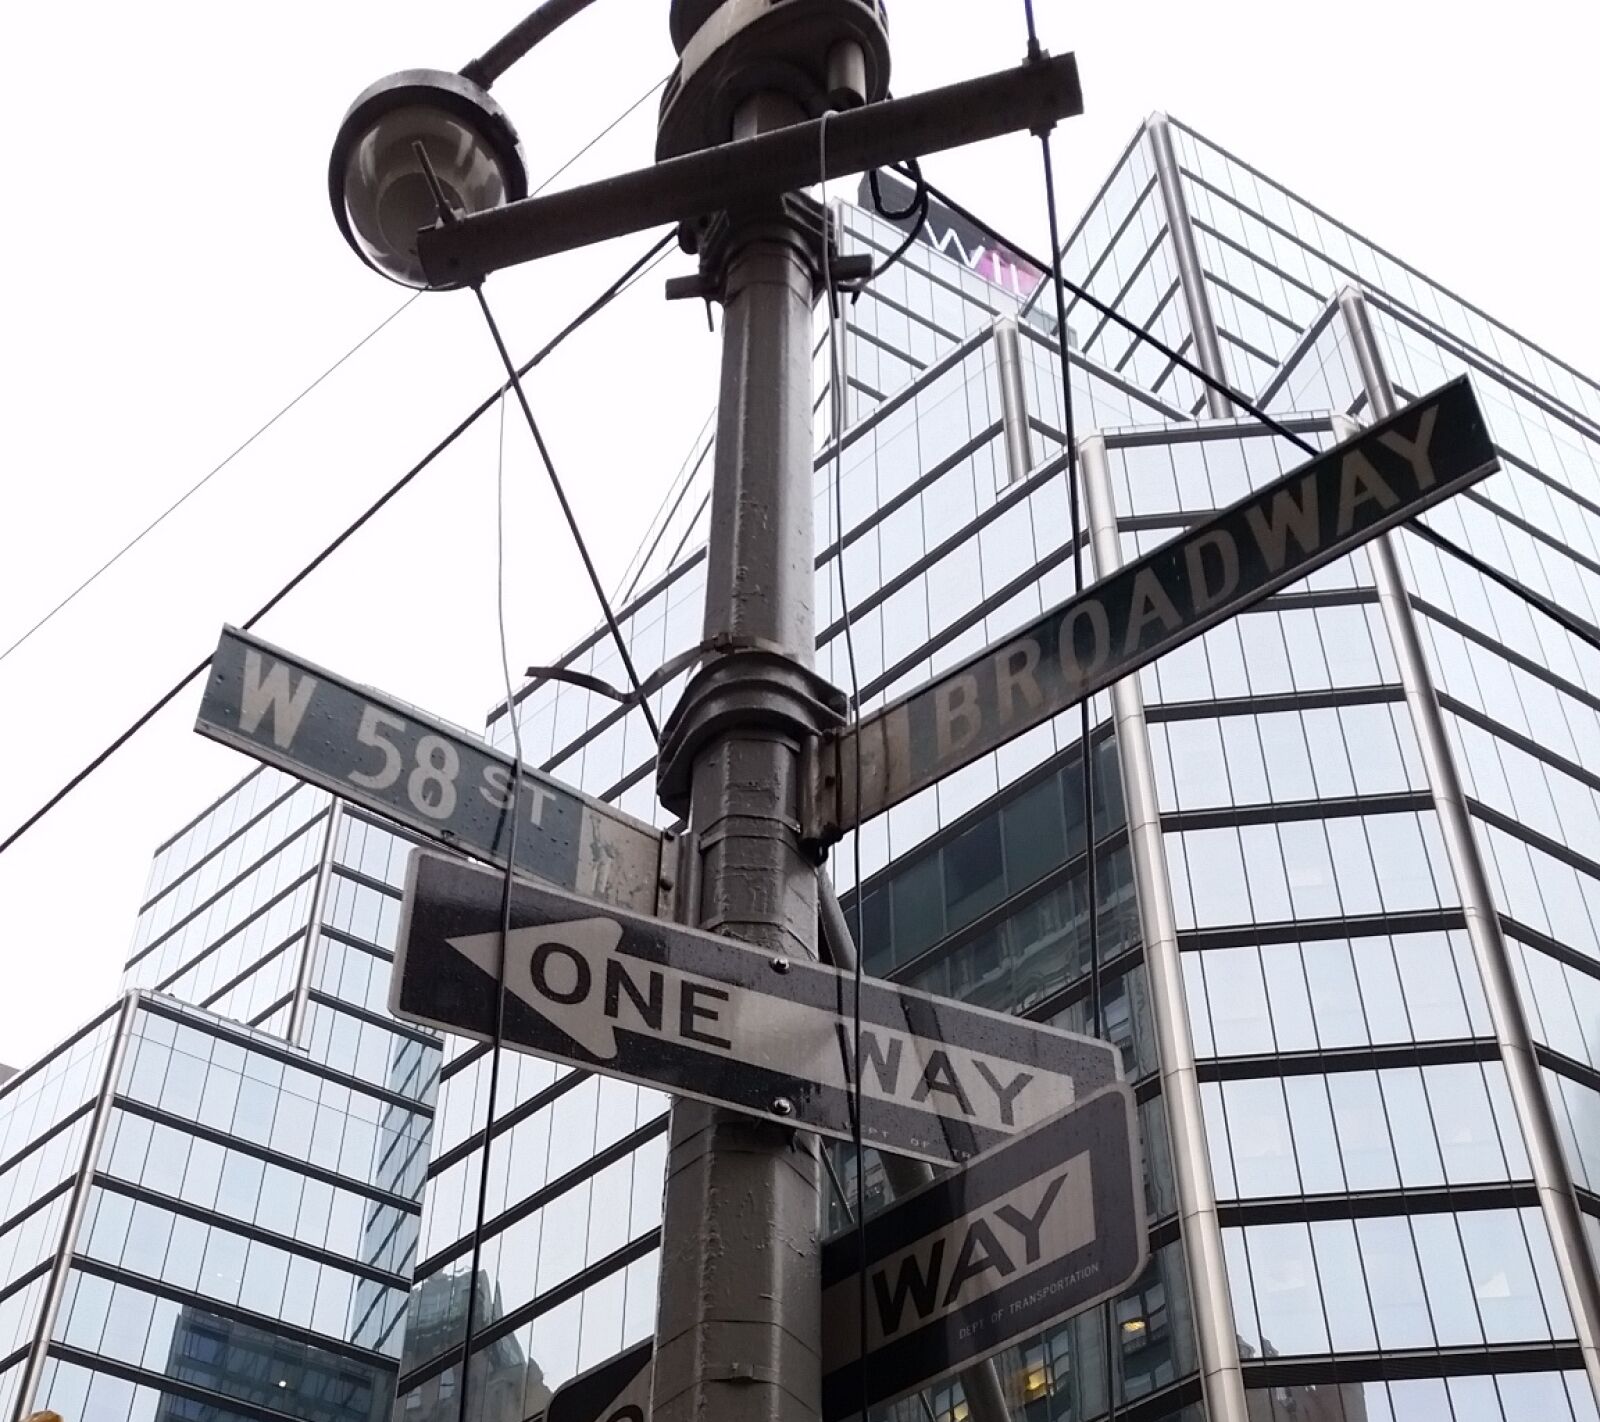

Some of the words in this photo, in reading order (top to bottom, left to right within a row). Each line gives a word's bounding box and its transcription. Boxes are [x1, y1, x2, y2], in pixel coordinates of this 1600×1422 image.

[935, 405, 1441, 760] BROADWAY
[238, 649, 319, 750] W
[347, 702, 461, 819] 58
[479, 765, 558, 826] ST
[529, 941, 732, 1051] ONE
[836, 1020, 1035, 1127] WAY
[869, 1172, 1071, 1338] WAY
[959, 1321, 984, 1340] DEPT
[991, 1309, 1005, 1323] OF
[1009, 1262, 1100, 1314] TRANSPORTATION
